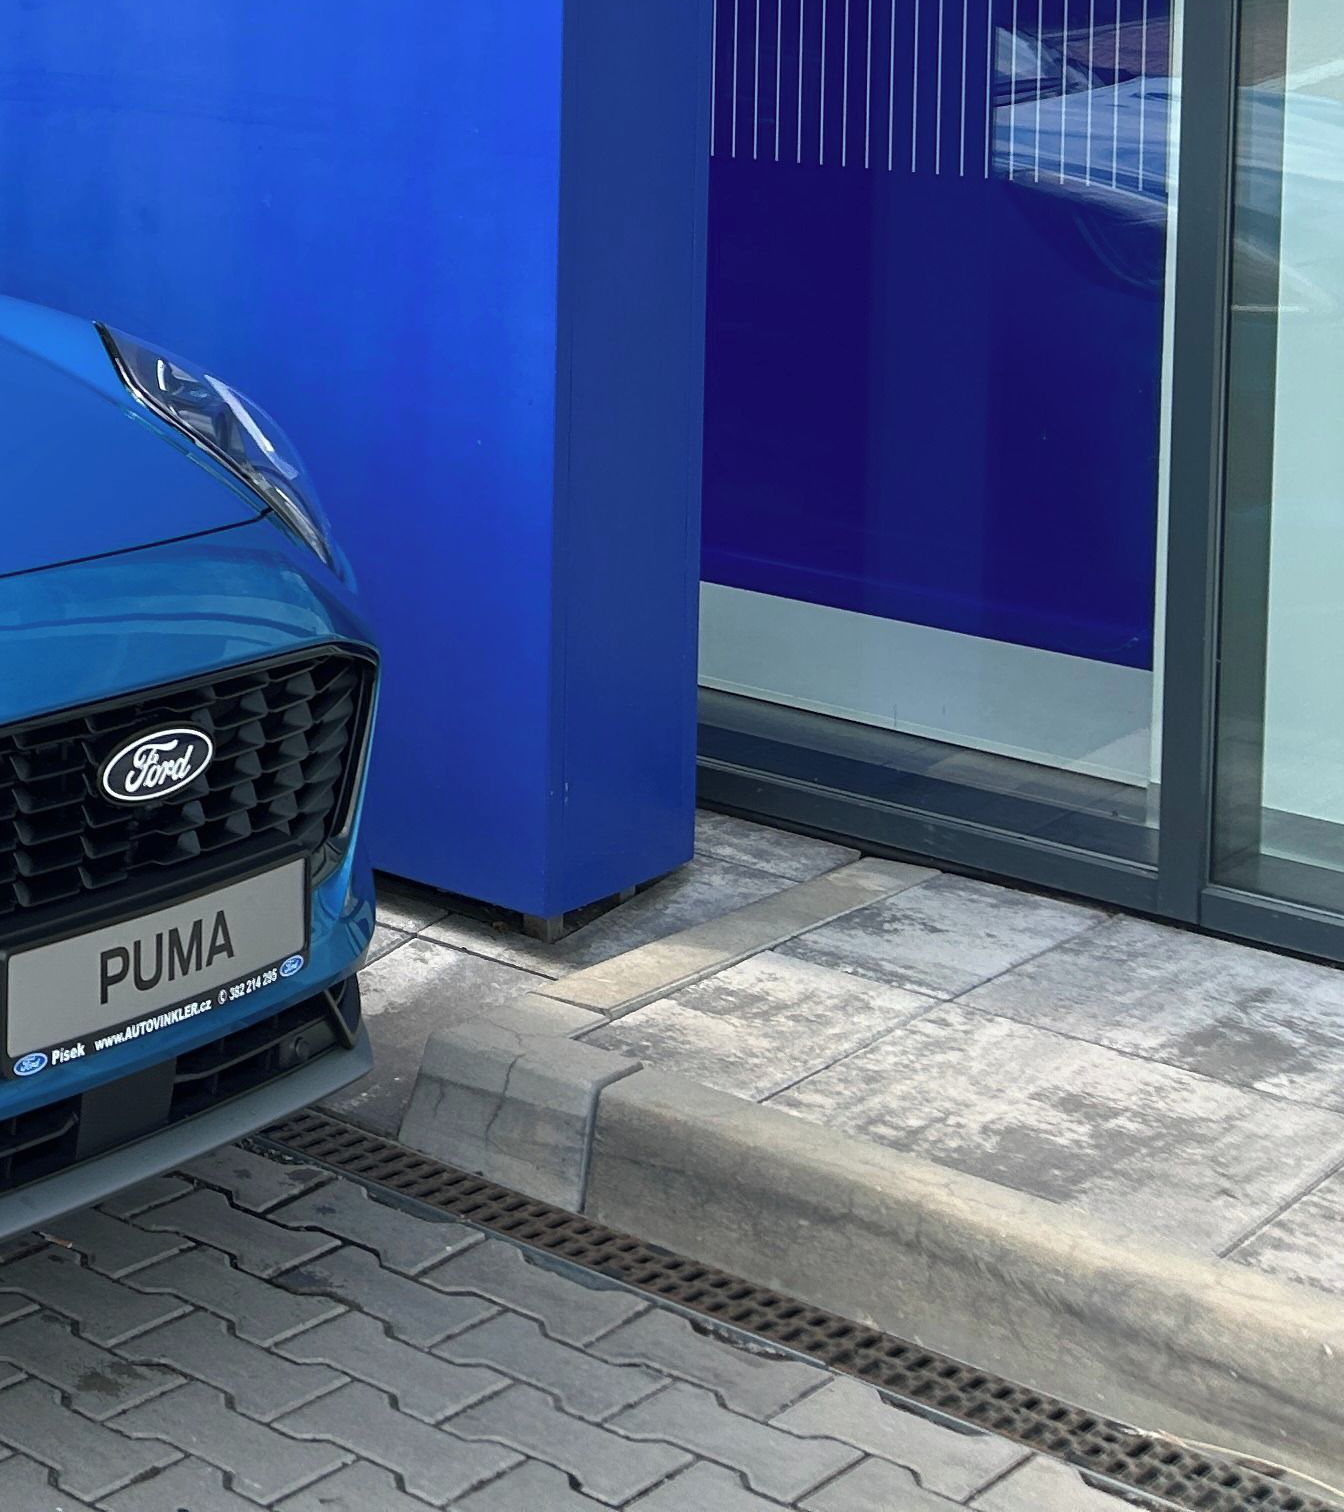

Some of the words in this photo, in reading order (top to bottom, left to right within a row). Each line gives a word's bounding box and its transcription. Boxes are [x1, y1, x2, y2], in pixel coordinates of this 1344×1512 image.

[124, 738, 195, 793] Ford
[100, 909, 235, 1005] PUMA
[94, 998, 213, 1051] www.AUTOVINKLER.cz
[246, 975, 262, 994] 214
